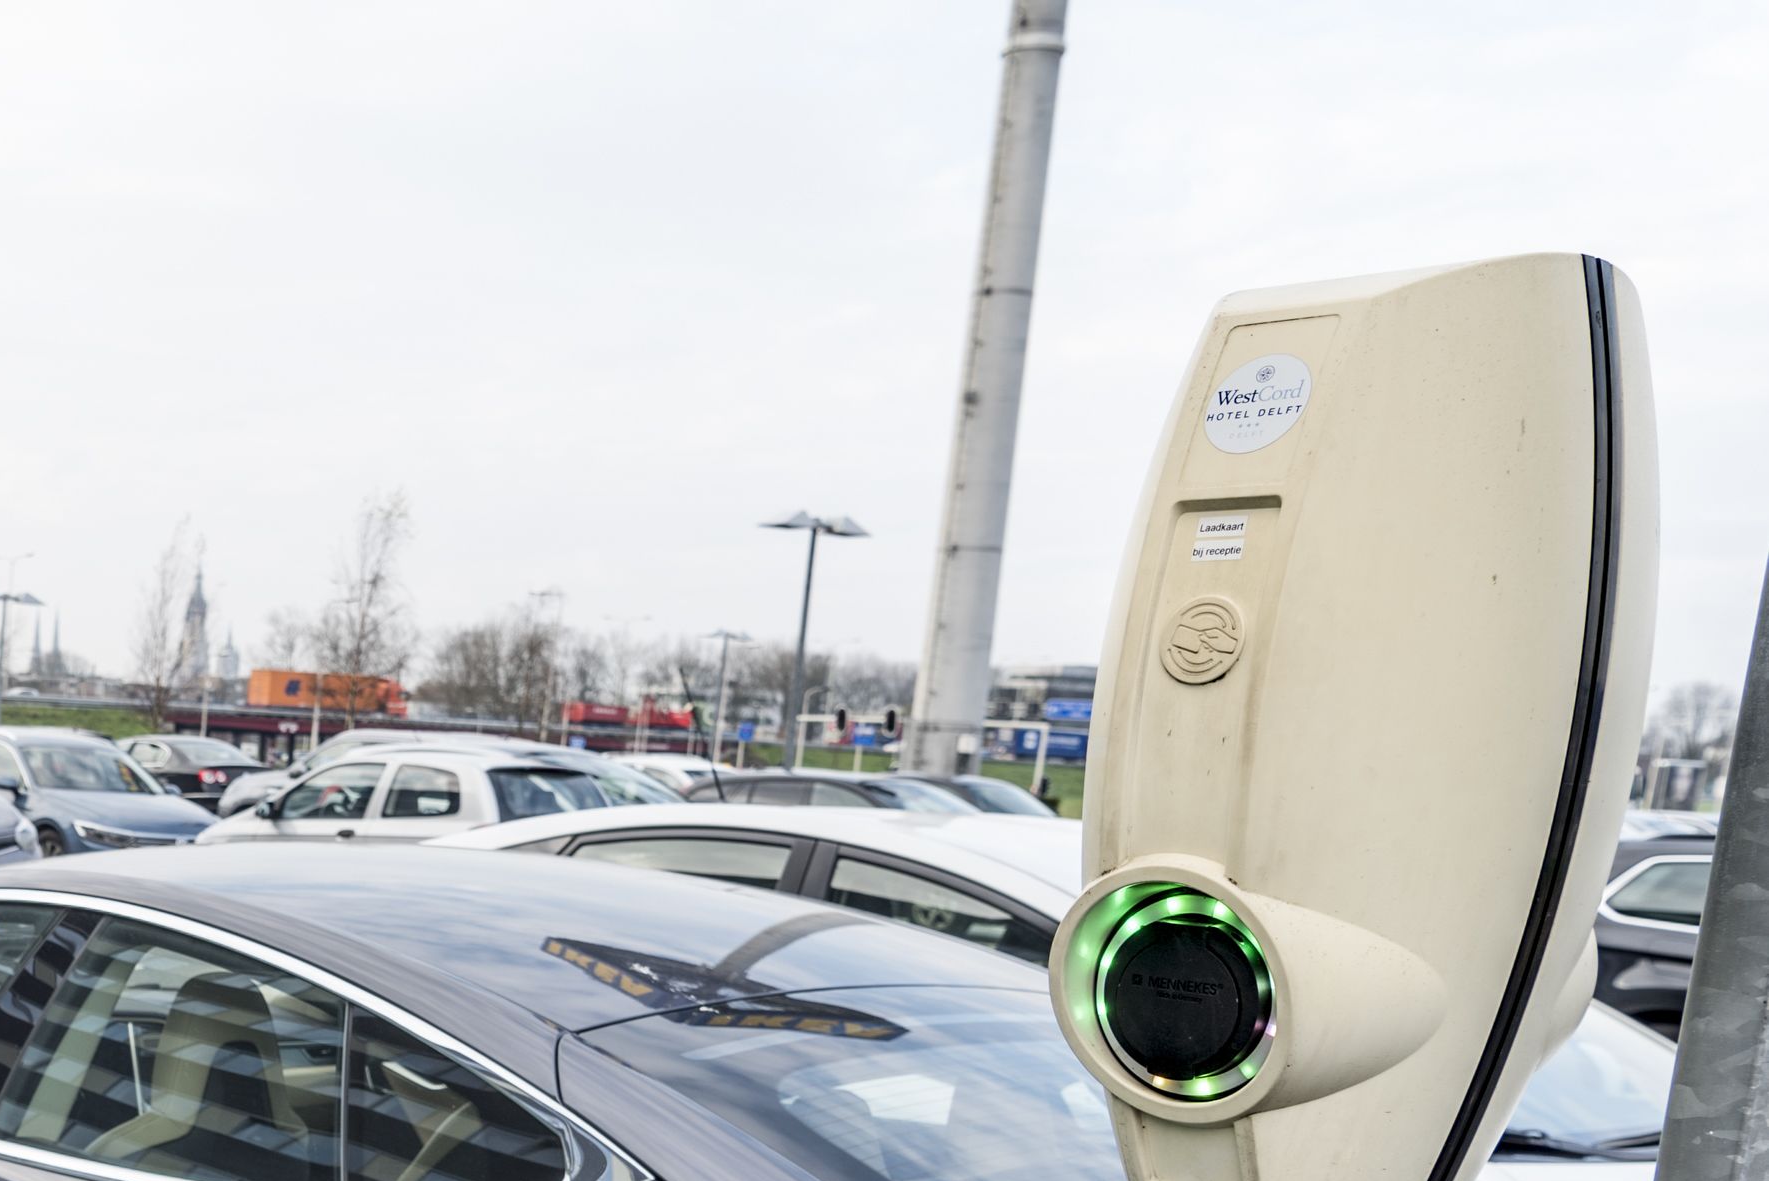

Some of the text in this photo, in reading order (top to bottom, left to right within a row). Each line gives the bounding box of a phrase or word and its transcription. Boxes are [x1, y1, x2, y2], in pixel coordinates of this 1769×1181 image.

[1217, 379, 1305, 406] WestCord
[1206, 405, 1302, 422] HOTEL DELFT
[1199, 523, 1244, 533] Laadkaart
[1192, 546, 1242, 558] bij receptie
